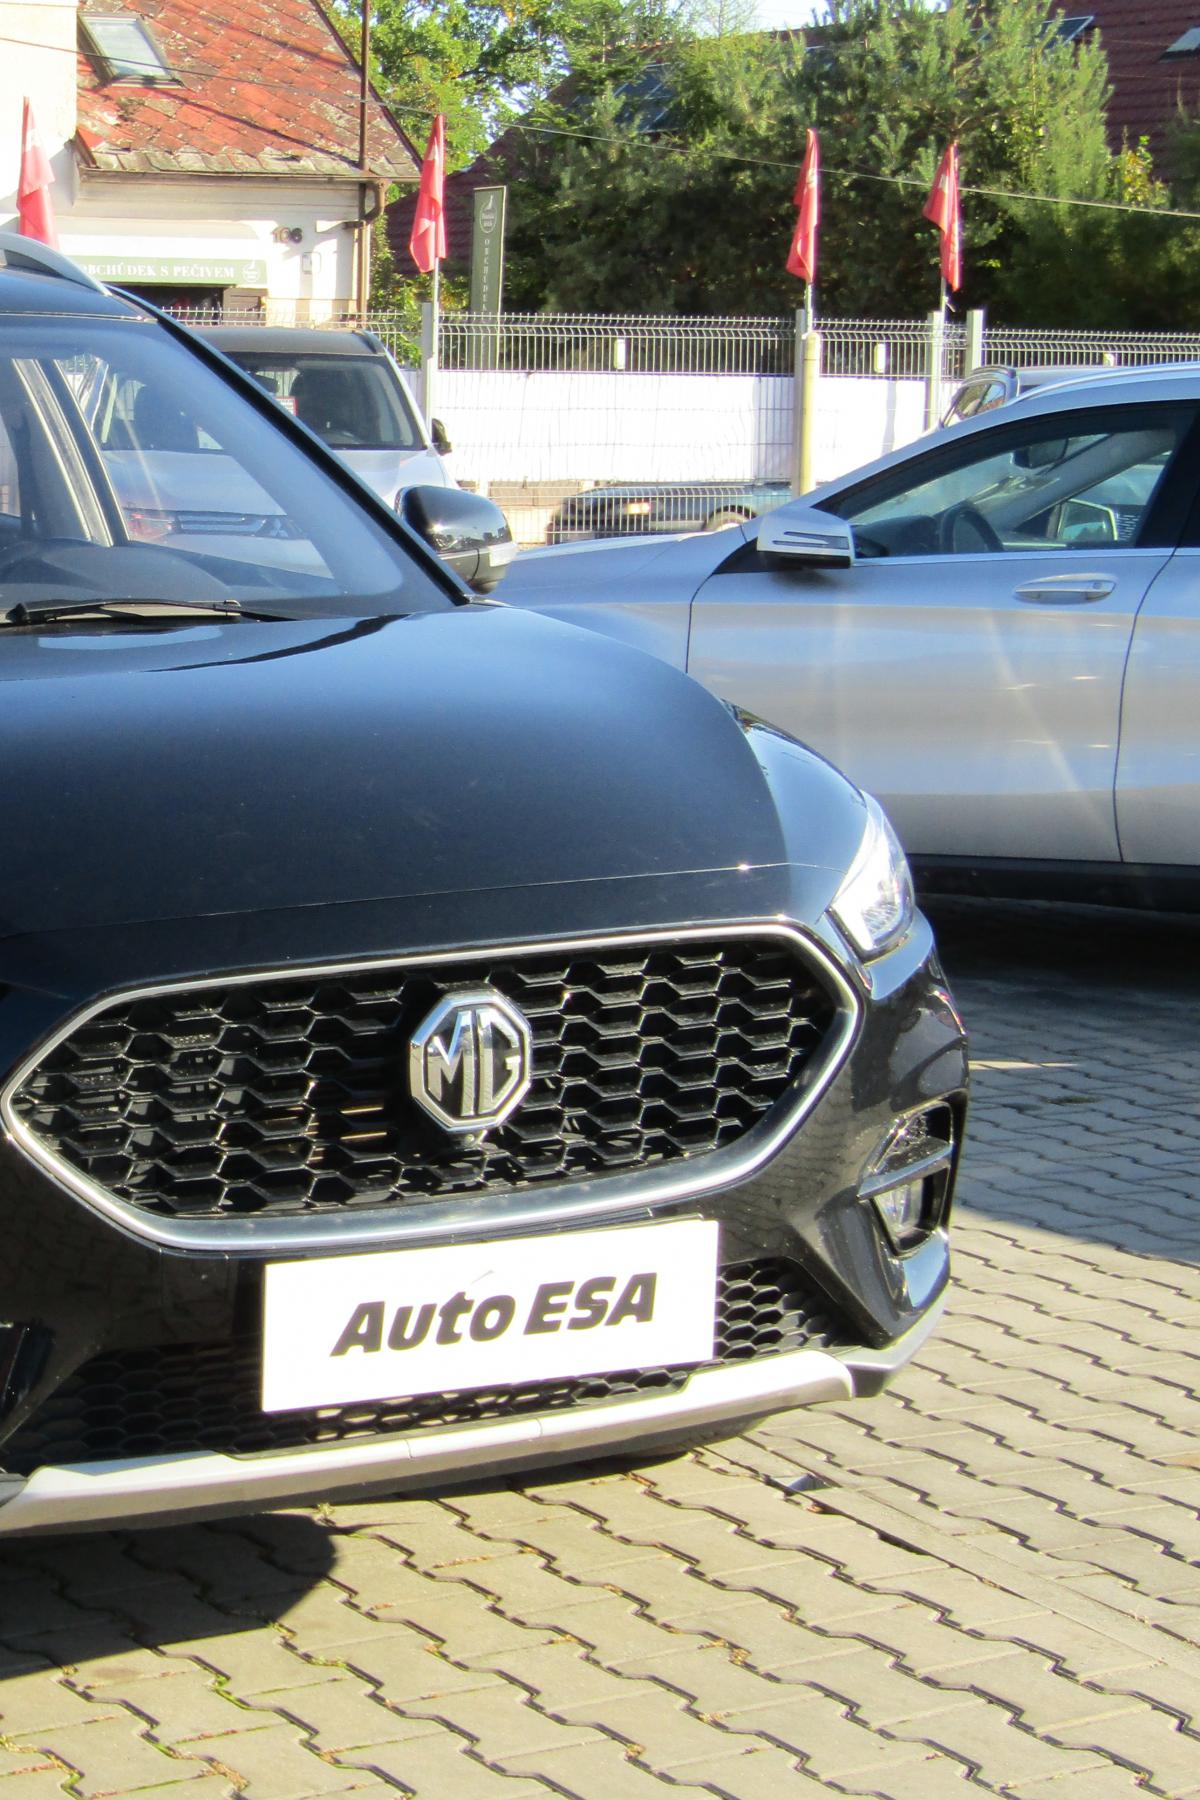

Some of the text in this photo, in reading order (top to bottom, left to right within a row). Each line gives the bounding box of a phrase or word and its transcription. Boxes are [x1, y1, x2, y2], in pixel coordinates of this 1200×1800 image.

[160, 264, 169, 277] S
[173, 263, 234, 279] PEČIVEM
[424, 1004, 524, 1119] MG
[329, 1272, 658, 1358] Auto ESA
